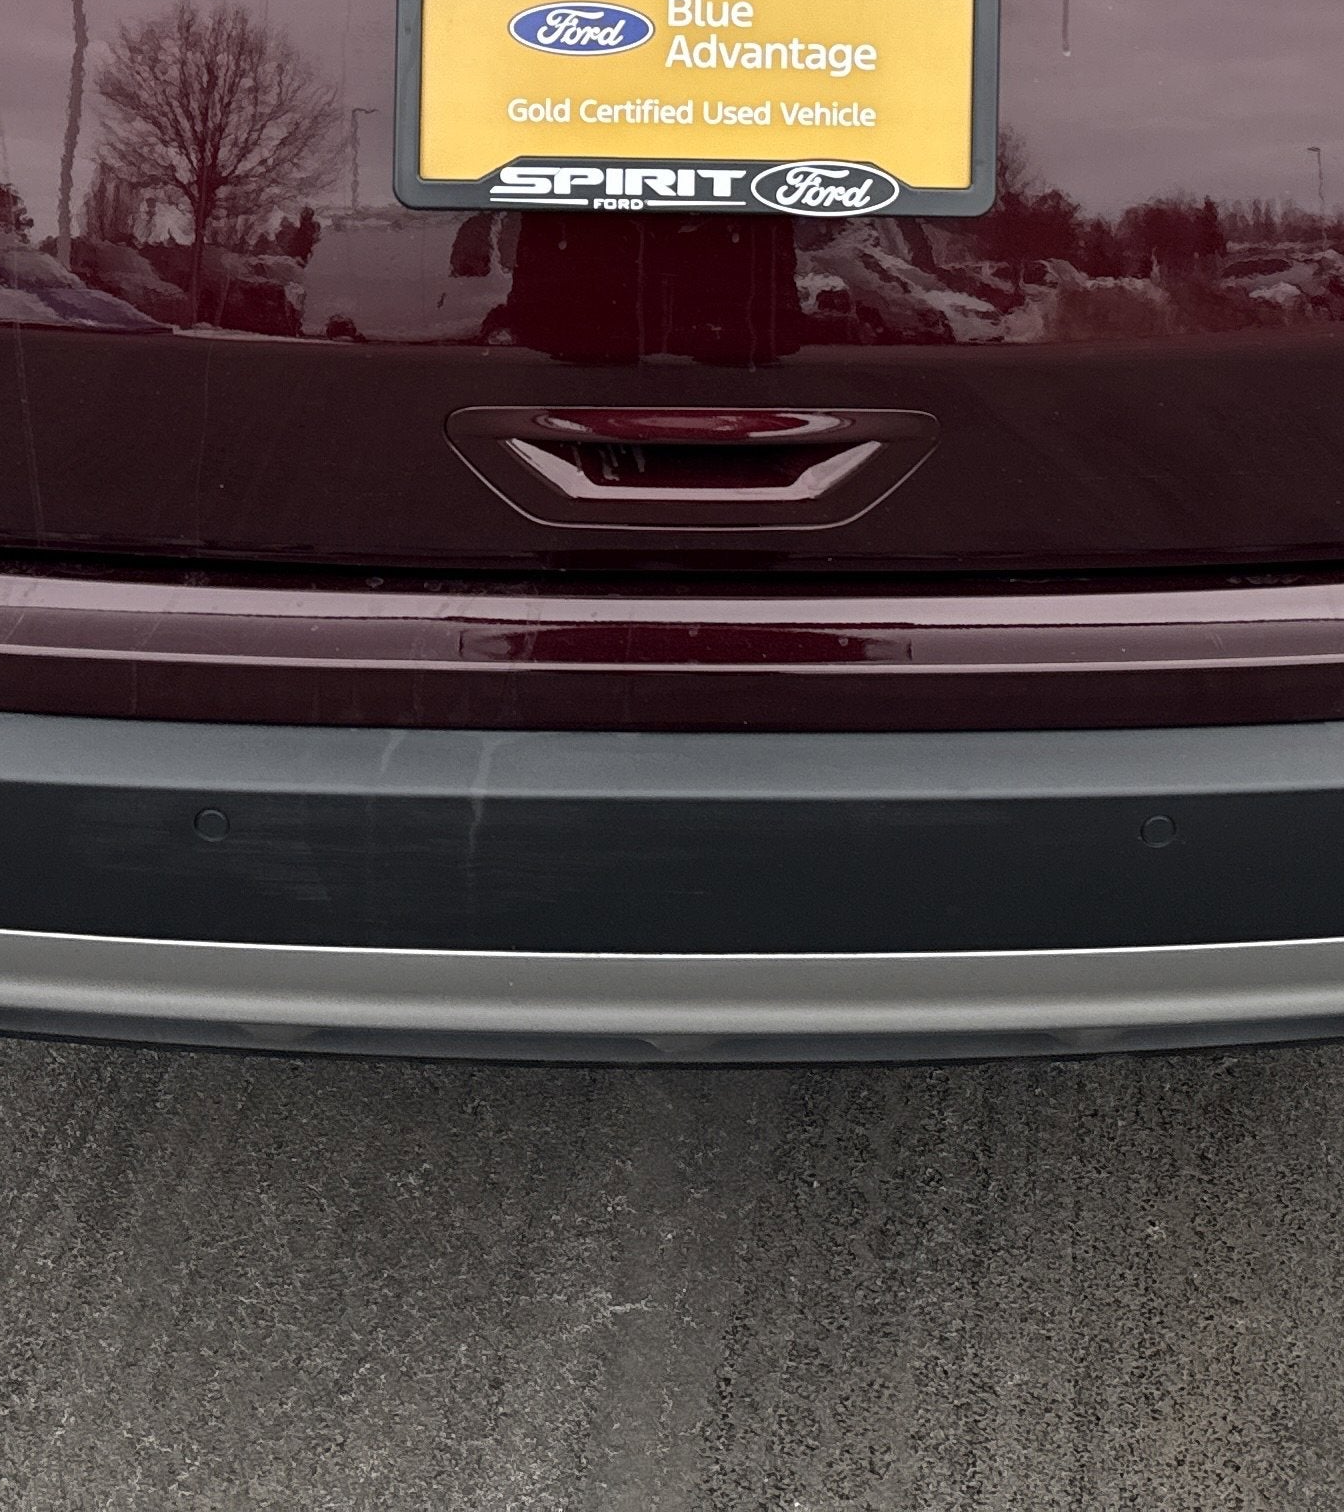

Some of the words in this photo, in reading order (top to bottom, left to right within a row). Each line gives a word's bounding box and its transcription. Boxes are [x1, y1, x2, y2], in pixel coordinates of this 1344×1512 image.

[536, 8, 626, 46] Ford
[664, 34, 878, 77] Advantage
[507, 98, 571, 123] Gold
[578, 98, 694, 125] Certified
[702, 100, 771, 126] Used
[779, 101, 877, 127] Vehicle
[490, 166, 747, 197] SPIRIT
[775, 165, 871, 208] Ford
[593, 198, 644, 210] FORD
